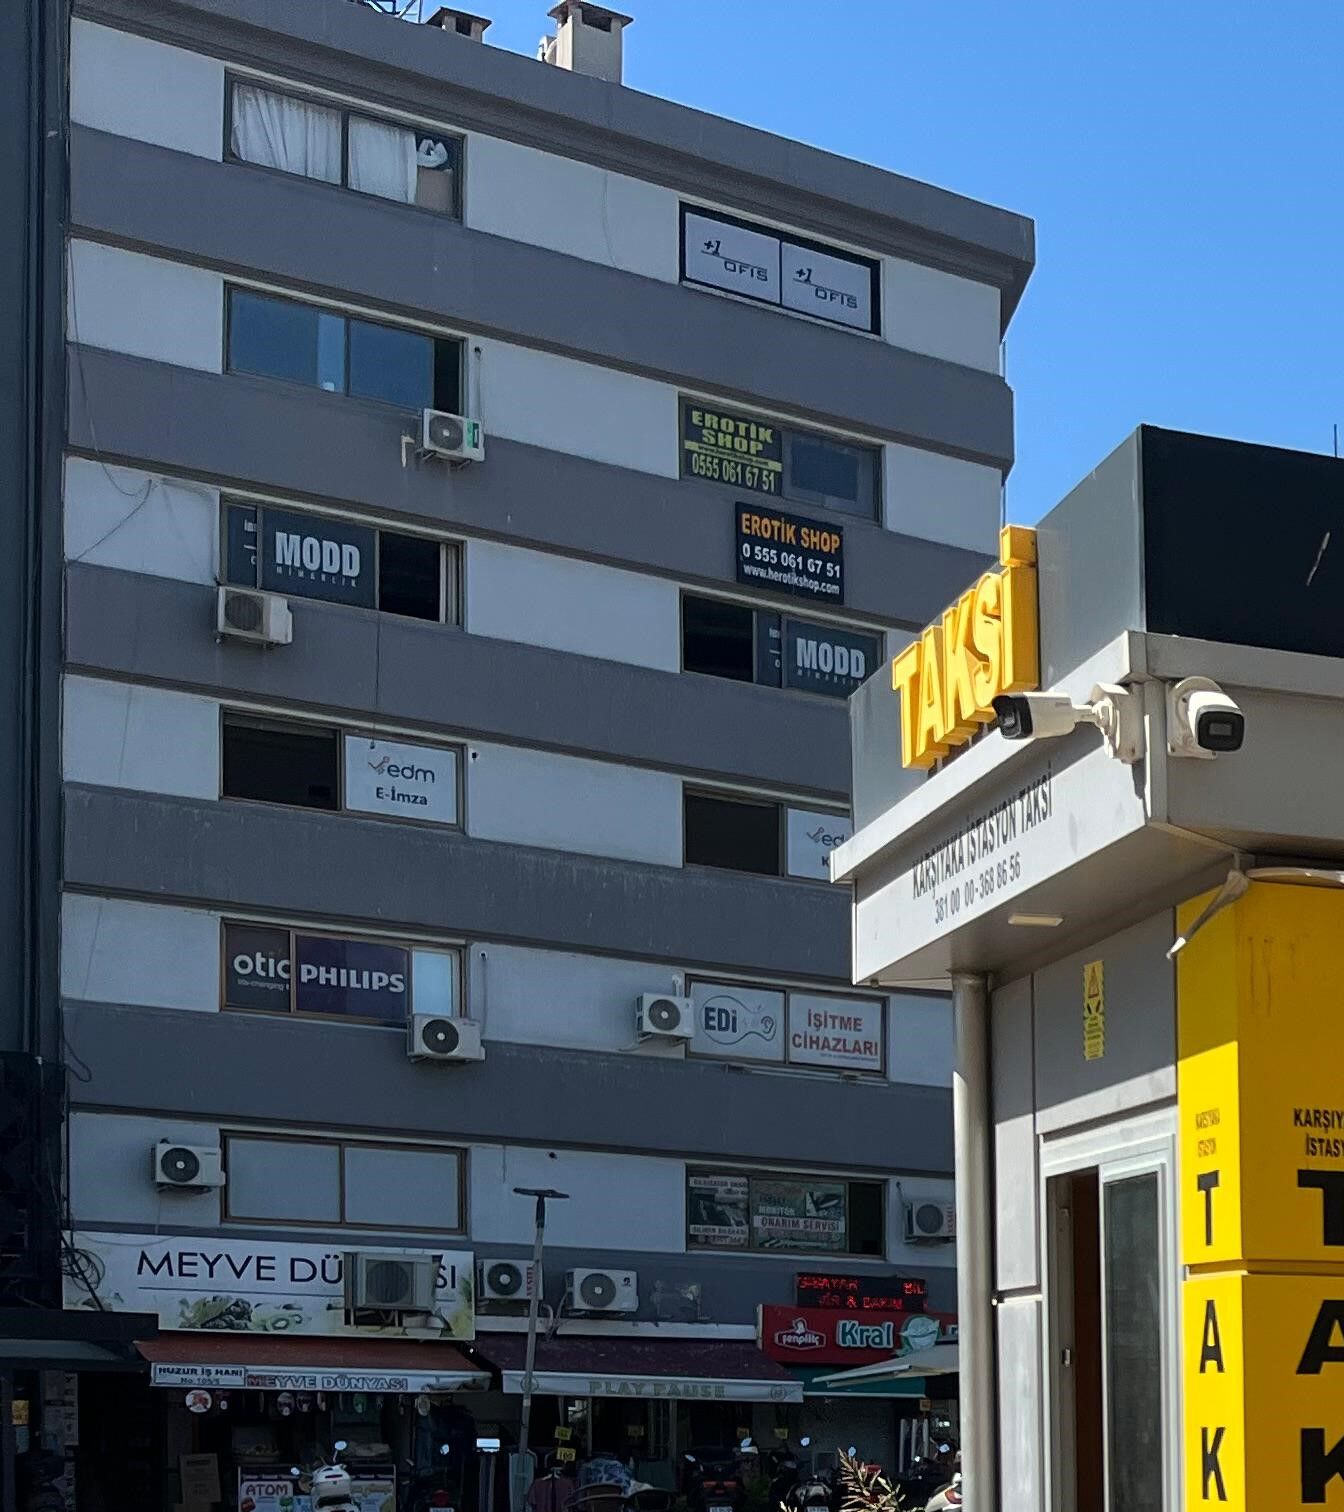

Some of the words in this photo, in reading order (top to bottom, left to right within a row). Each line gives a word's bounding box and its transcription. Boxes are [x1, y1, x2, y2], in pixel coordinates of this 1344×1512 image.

[692, 410, 774, 444] EROTİK
[702, 428, 764, 454] SHOP
[692, 453, 719, 478] 0555
[722, 460, 742, 484] 061
[746, 467, 758, 488] 67
[762, 471, 775, 492] 51
[741, 513, 796, 545] EROTİK
[801, 527, 841, 554] SHOP
[275, 531, 360, 577] MODD
[742, 543, 751, 558] 0
[754, 546, 778, 564] 555
[781, 552, 803, 570] 061
[807, 558, 822, 574] 67
[826, 562, 841, 579] 51
[796, 637, 865, 679] MODD
[892, 525, 1039, 770] TAKSİ
[387, 764, 435, 784] edm
[822, 834, 845, 847] ed
[913, 831, 965, 900] KARŞIYAKA
[966, 796, 1017, 866] İSTASYON
[1019, 760, 1053, 834] TAKSİ
[935, 893, 948, 924] 381
[950, 887, 961, 915] 00
[996, 859, 1008, 889] 86
[1009, 851, 1021, 883] 56
[301, 964, 405, 993] PHILIPS
[808, 1009, 862, 1032] İŞİTME
[792, 1031, 878, 1057] CİHAZLARI
[137, 1250, 276, 1281] MEYVE
[290, 1254, 456, 1290] DÜSI
[837, 1320, 894, 1349] Kral
[158, 1367, 198, 1375] HUZUR
[247, 1375, 316, 1388] MEYVE
[322, 1375, 408, 1391] DÜNYASI
[589, 1381, 643, 1395] PLAY
[246, 1484, 288, 1496] ATOM
